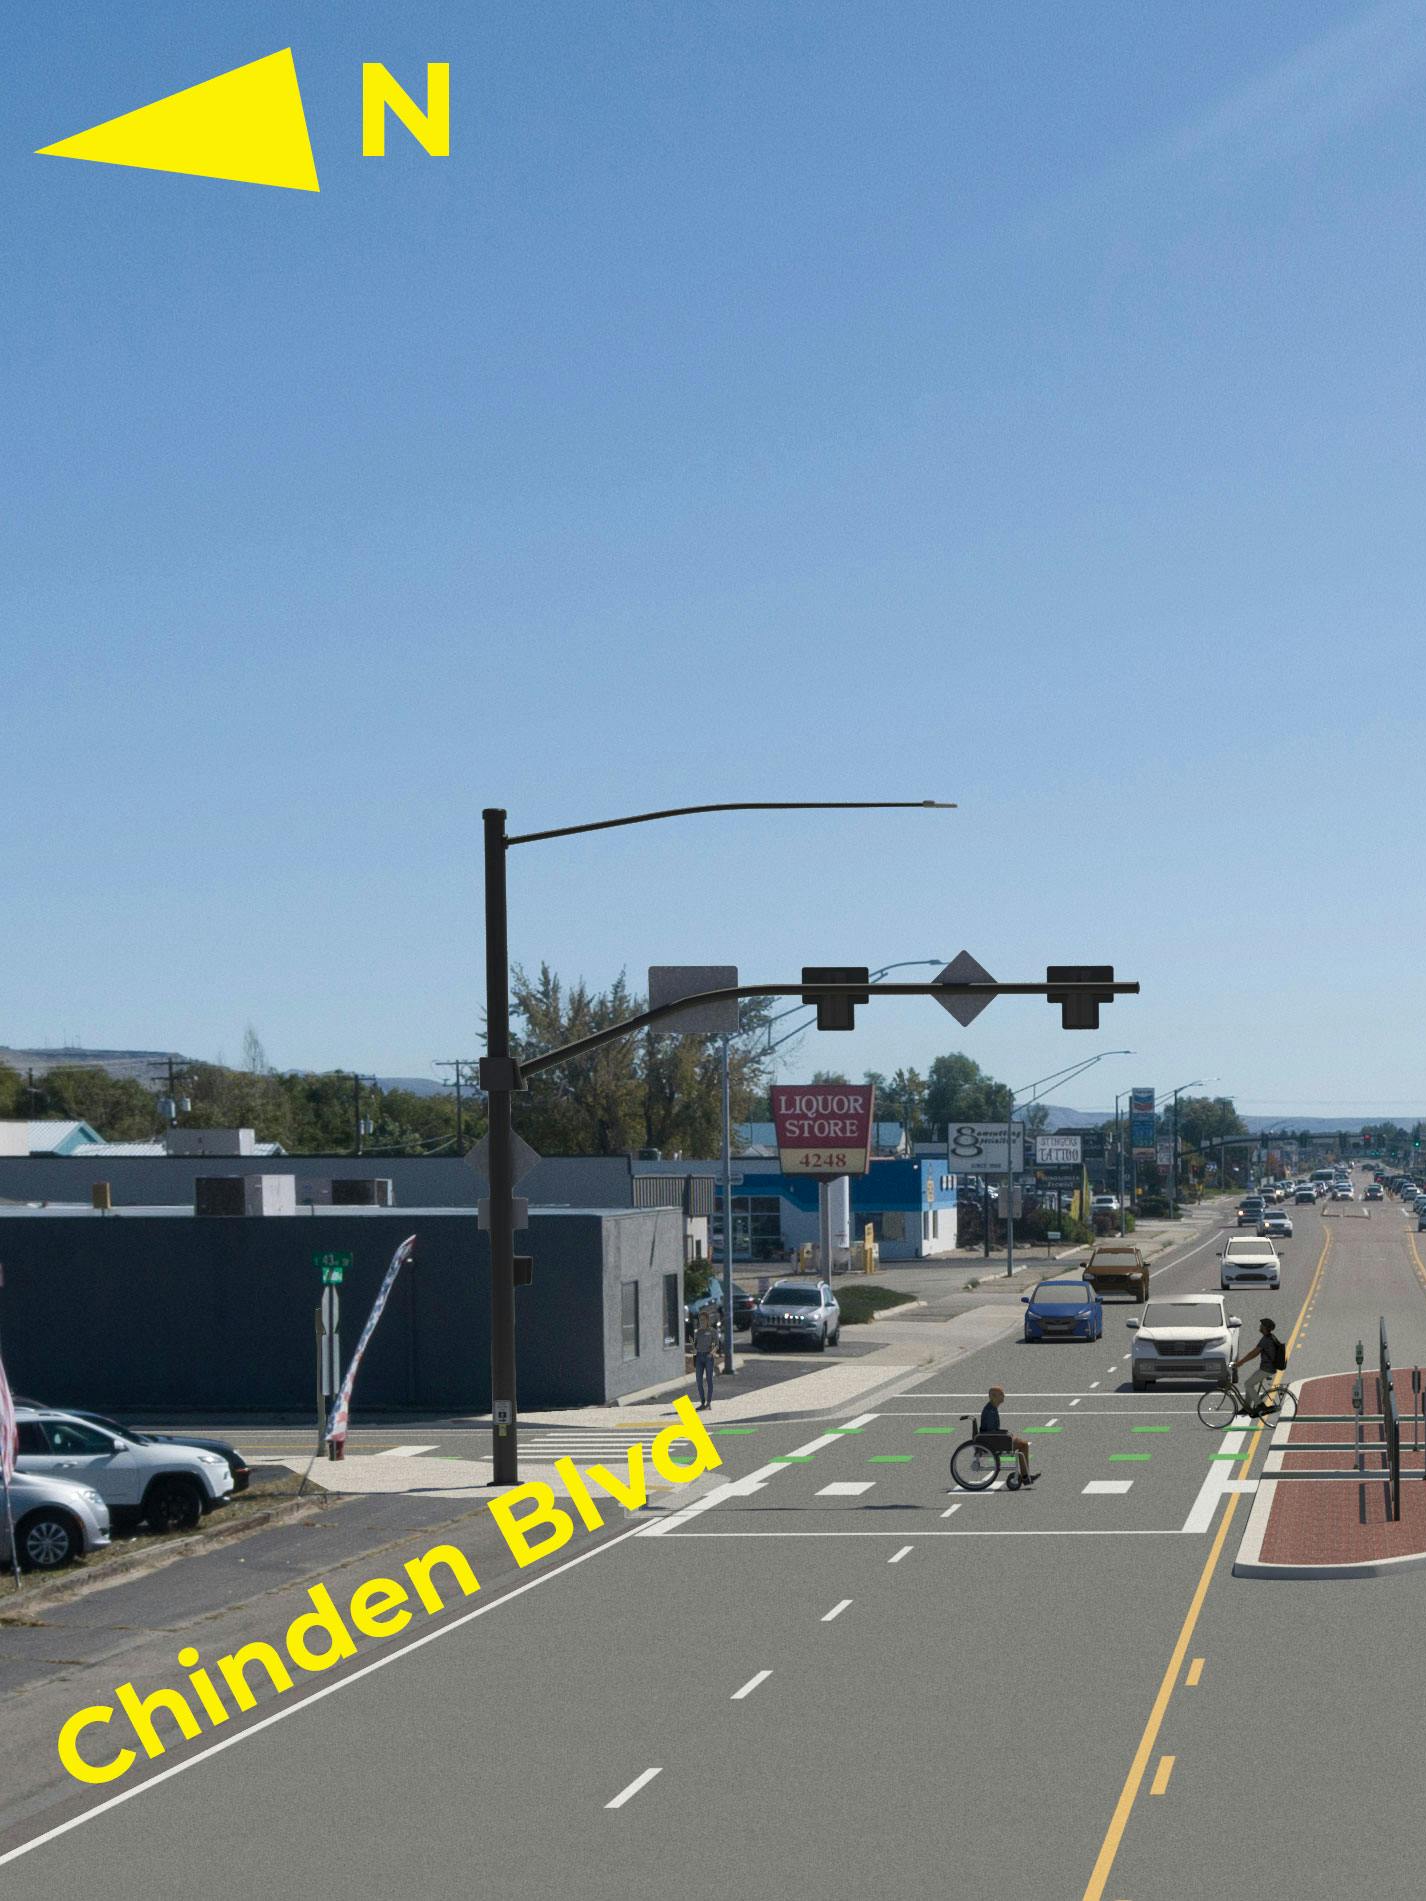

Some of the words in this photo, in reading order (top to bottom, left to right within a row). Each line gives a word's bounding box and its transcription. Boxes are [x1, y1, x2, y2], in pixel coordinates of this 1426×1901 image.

[779, 1095, 865, 1118] LIQUOR
[785, 1120, 859, 1137] STORE
[799, 1153, 847, 1168] 4248
[1040, 1148, 1079, 1161] TATTOO
